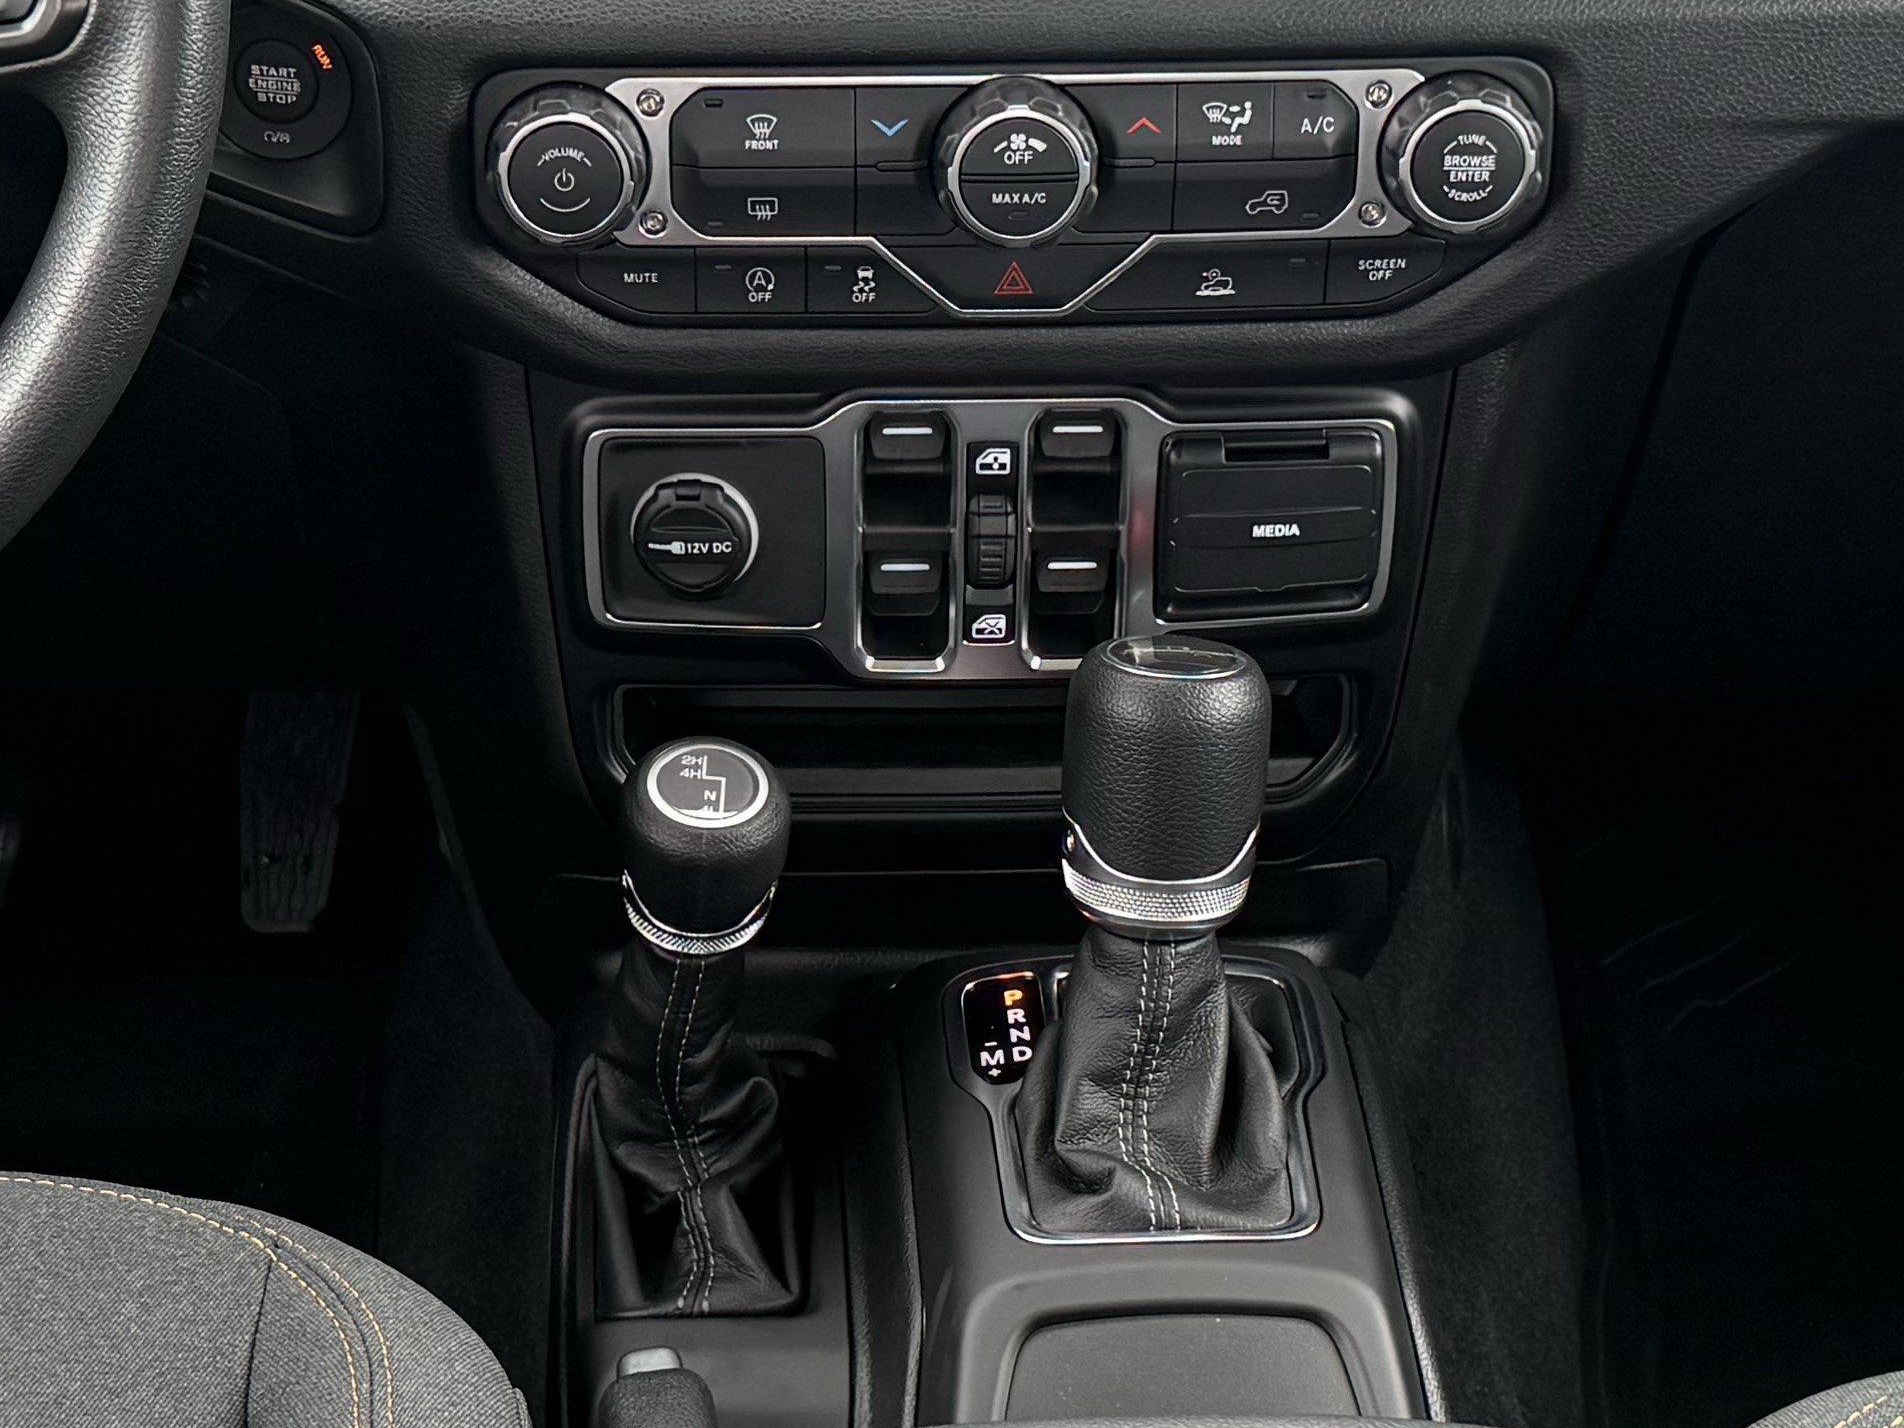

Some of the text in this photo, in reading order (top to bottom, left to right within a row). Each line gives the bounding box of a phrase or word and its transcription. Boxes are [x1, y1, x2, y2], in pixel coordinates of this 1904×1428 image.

[312, 44, 333, 70] RUN
[250, 65, 297, 77] START
[249, 78, 301, 91] ENGINE
[257, 93, 297, 104] STOP
[1301, 115, 1334, 133] A/C
[744, 140, 780, 150] FRONT
[1211, 135, 1243, 146] MODE
[1457, 134, 1486, 146] TUNE
[542, 148, 586, 161] VOLUME
[1003, 151, 1034, 165] OFF
[1443, 155, 1497, 168] BROWSE
[1449, 170, 1491, 182] ENTER
[992, 192, 1050, 205] MAX A/C
[1447, 188, 1488, 203] SCROLL
[1359, 259, 1407, 271] SCREEN
[623, 272, 660, 284] MUTE
[1369, 269, 1394, 280] OFF
[748, 291, 772, 303] OFF
[851, 291, 876, 303] OFF
[1251, 522, 1301, 539] MEDIA
[685, 541, 733, 556] 12V DC
[681, 755, 702, 764] 2H
[680, 768, 701, 778] 4H
[704, 790, 717, 801] N
[1003, 990, 1023, 1007] P
[1007, 1009, 1027, 1026] R
[1010, 1027, 1031, 1044] N
[979, 1045, 1033, 1066] M D
